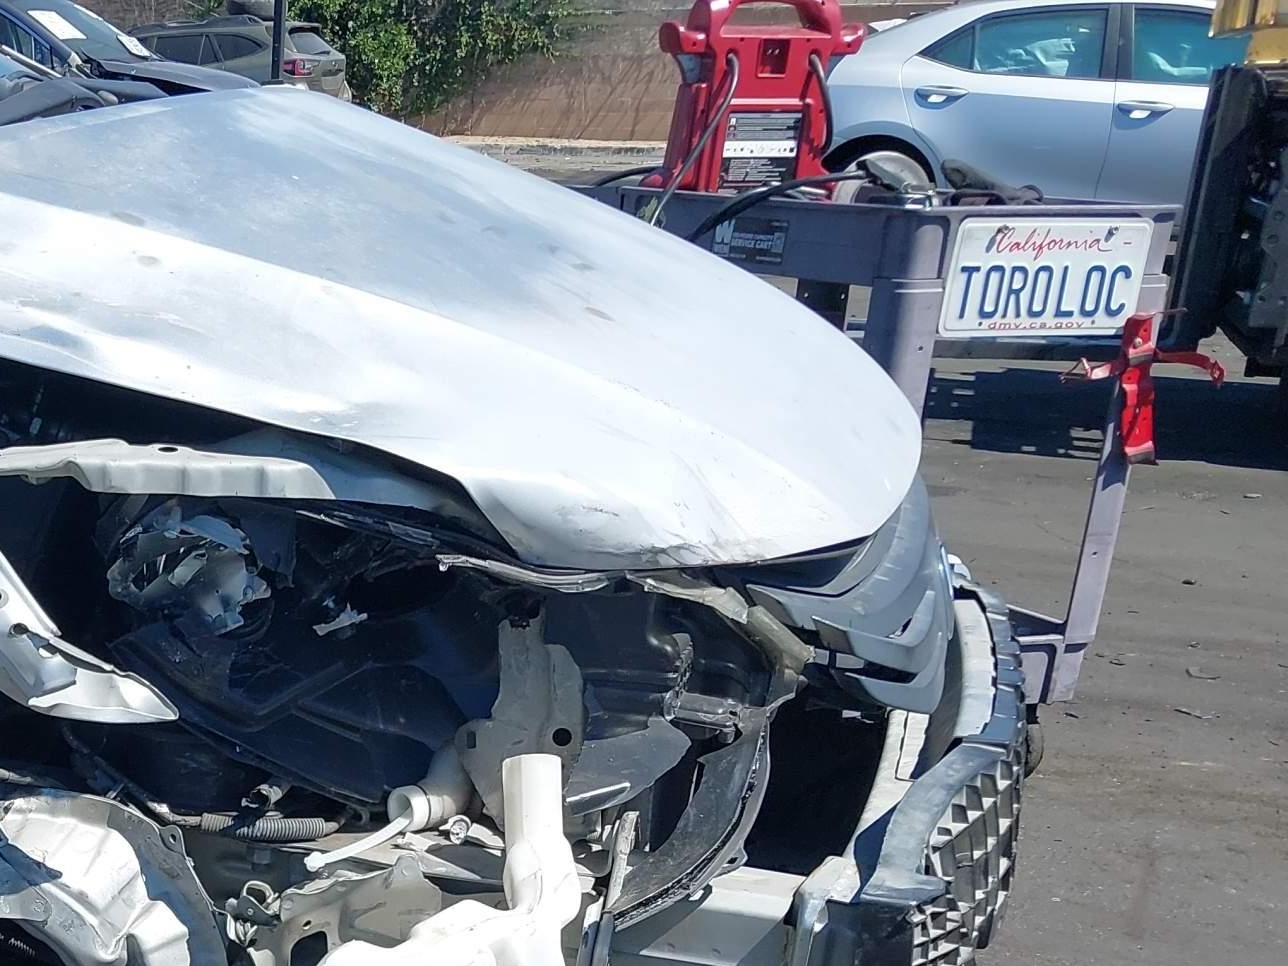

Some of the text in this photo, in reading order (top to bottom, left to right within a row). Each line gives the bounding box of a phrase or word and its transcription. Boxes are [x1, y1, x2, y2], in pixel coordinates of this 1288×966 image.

[996, 226, 1112, 262] California
[958, 264, 1133, 320] TOROLOC
[988, 320, 1085, 330] dmv.ca.gov
